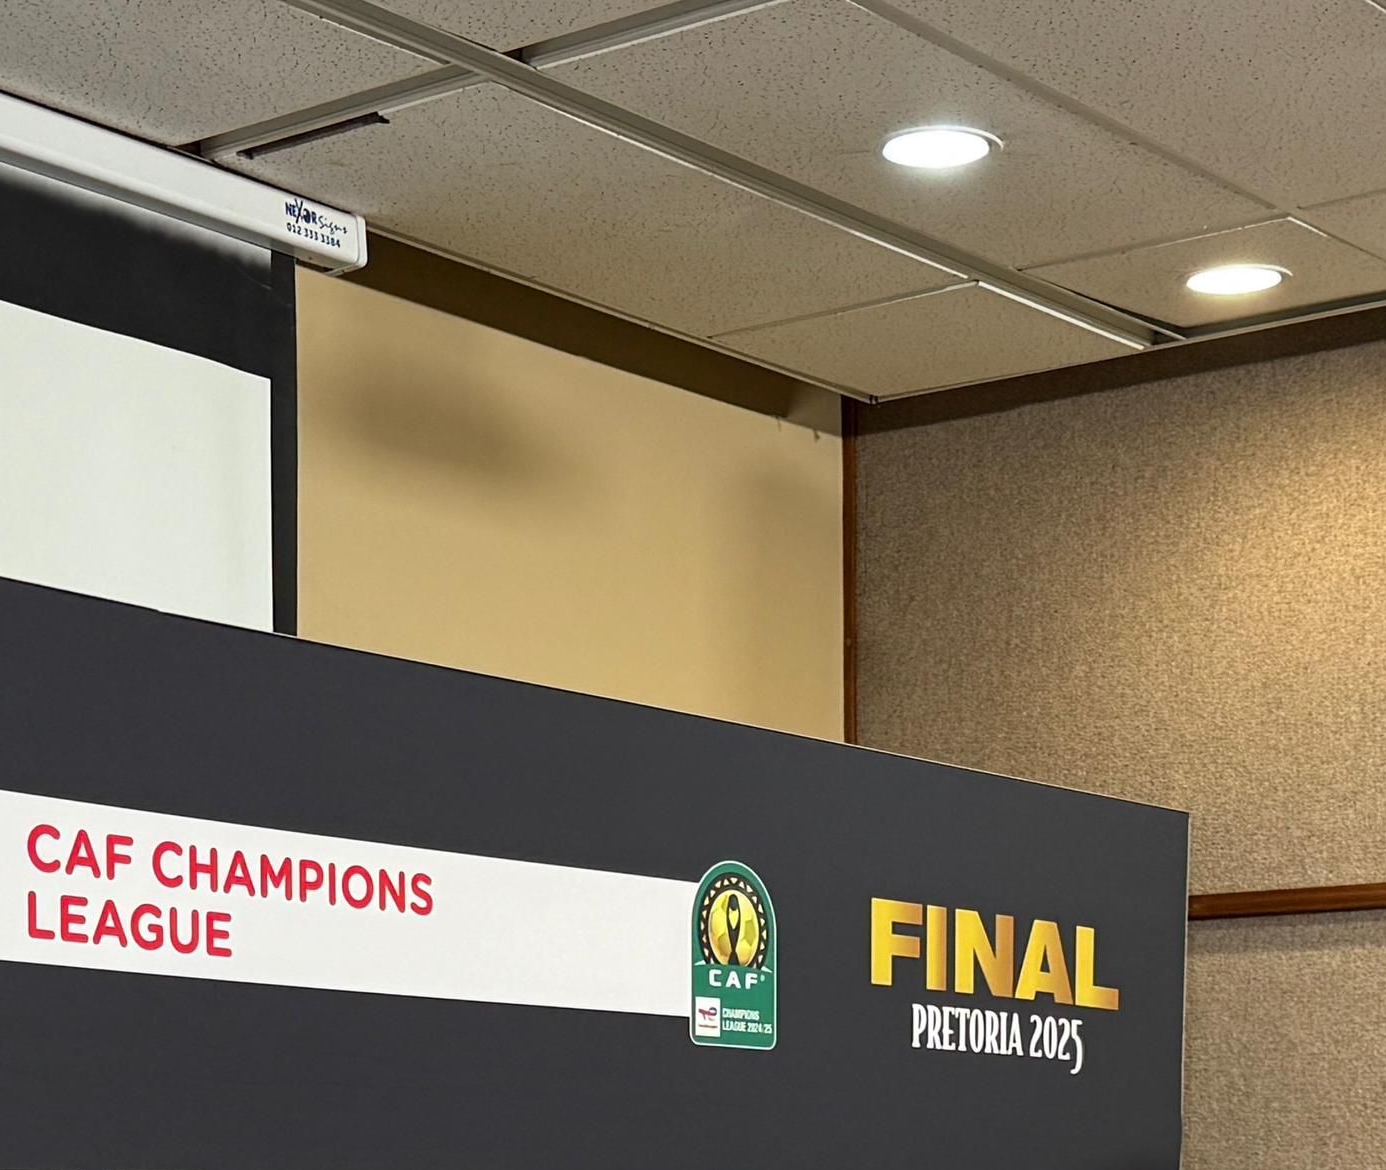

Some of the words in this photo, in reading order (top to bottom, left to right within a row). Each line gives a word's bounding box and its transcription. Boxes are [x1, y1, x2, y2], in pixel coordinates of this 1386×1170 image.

[27, 824, 133, 880] CAF
[152, 841, 434, 916] CHAMPIONS
[28, 891, 232, 957] LEAGUE
[871, 898, 1118, 1011] FINAL
[709, 969, 757, 989] CAF
[912, 1004, 1023, 1058] PRETORIA
[1030, 1015, 1086, 1074] 2025
